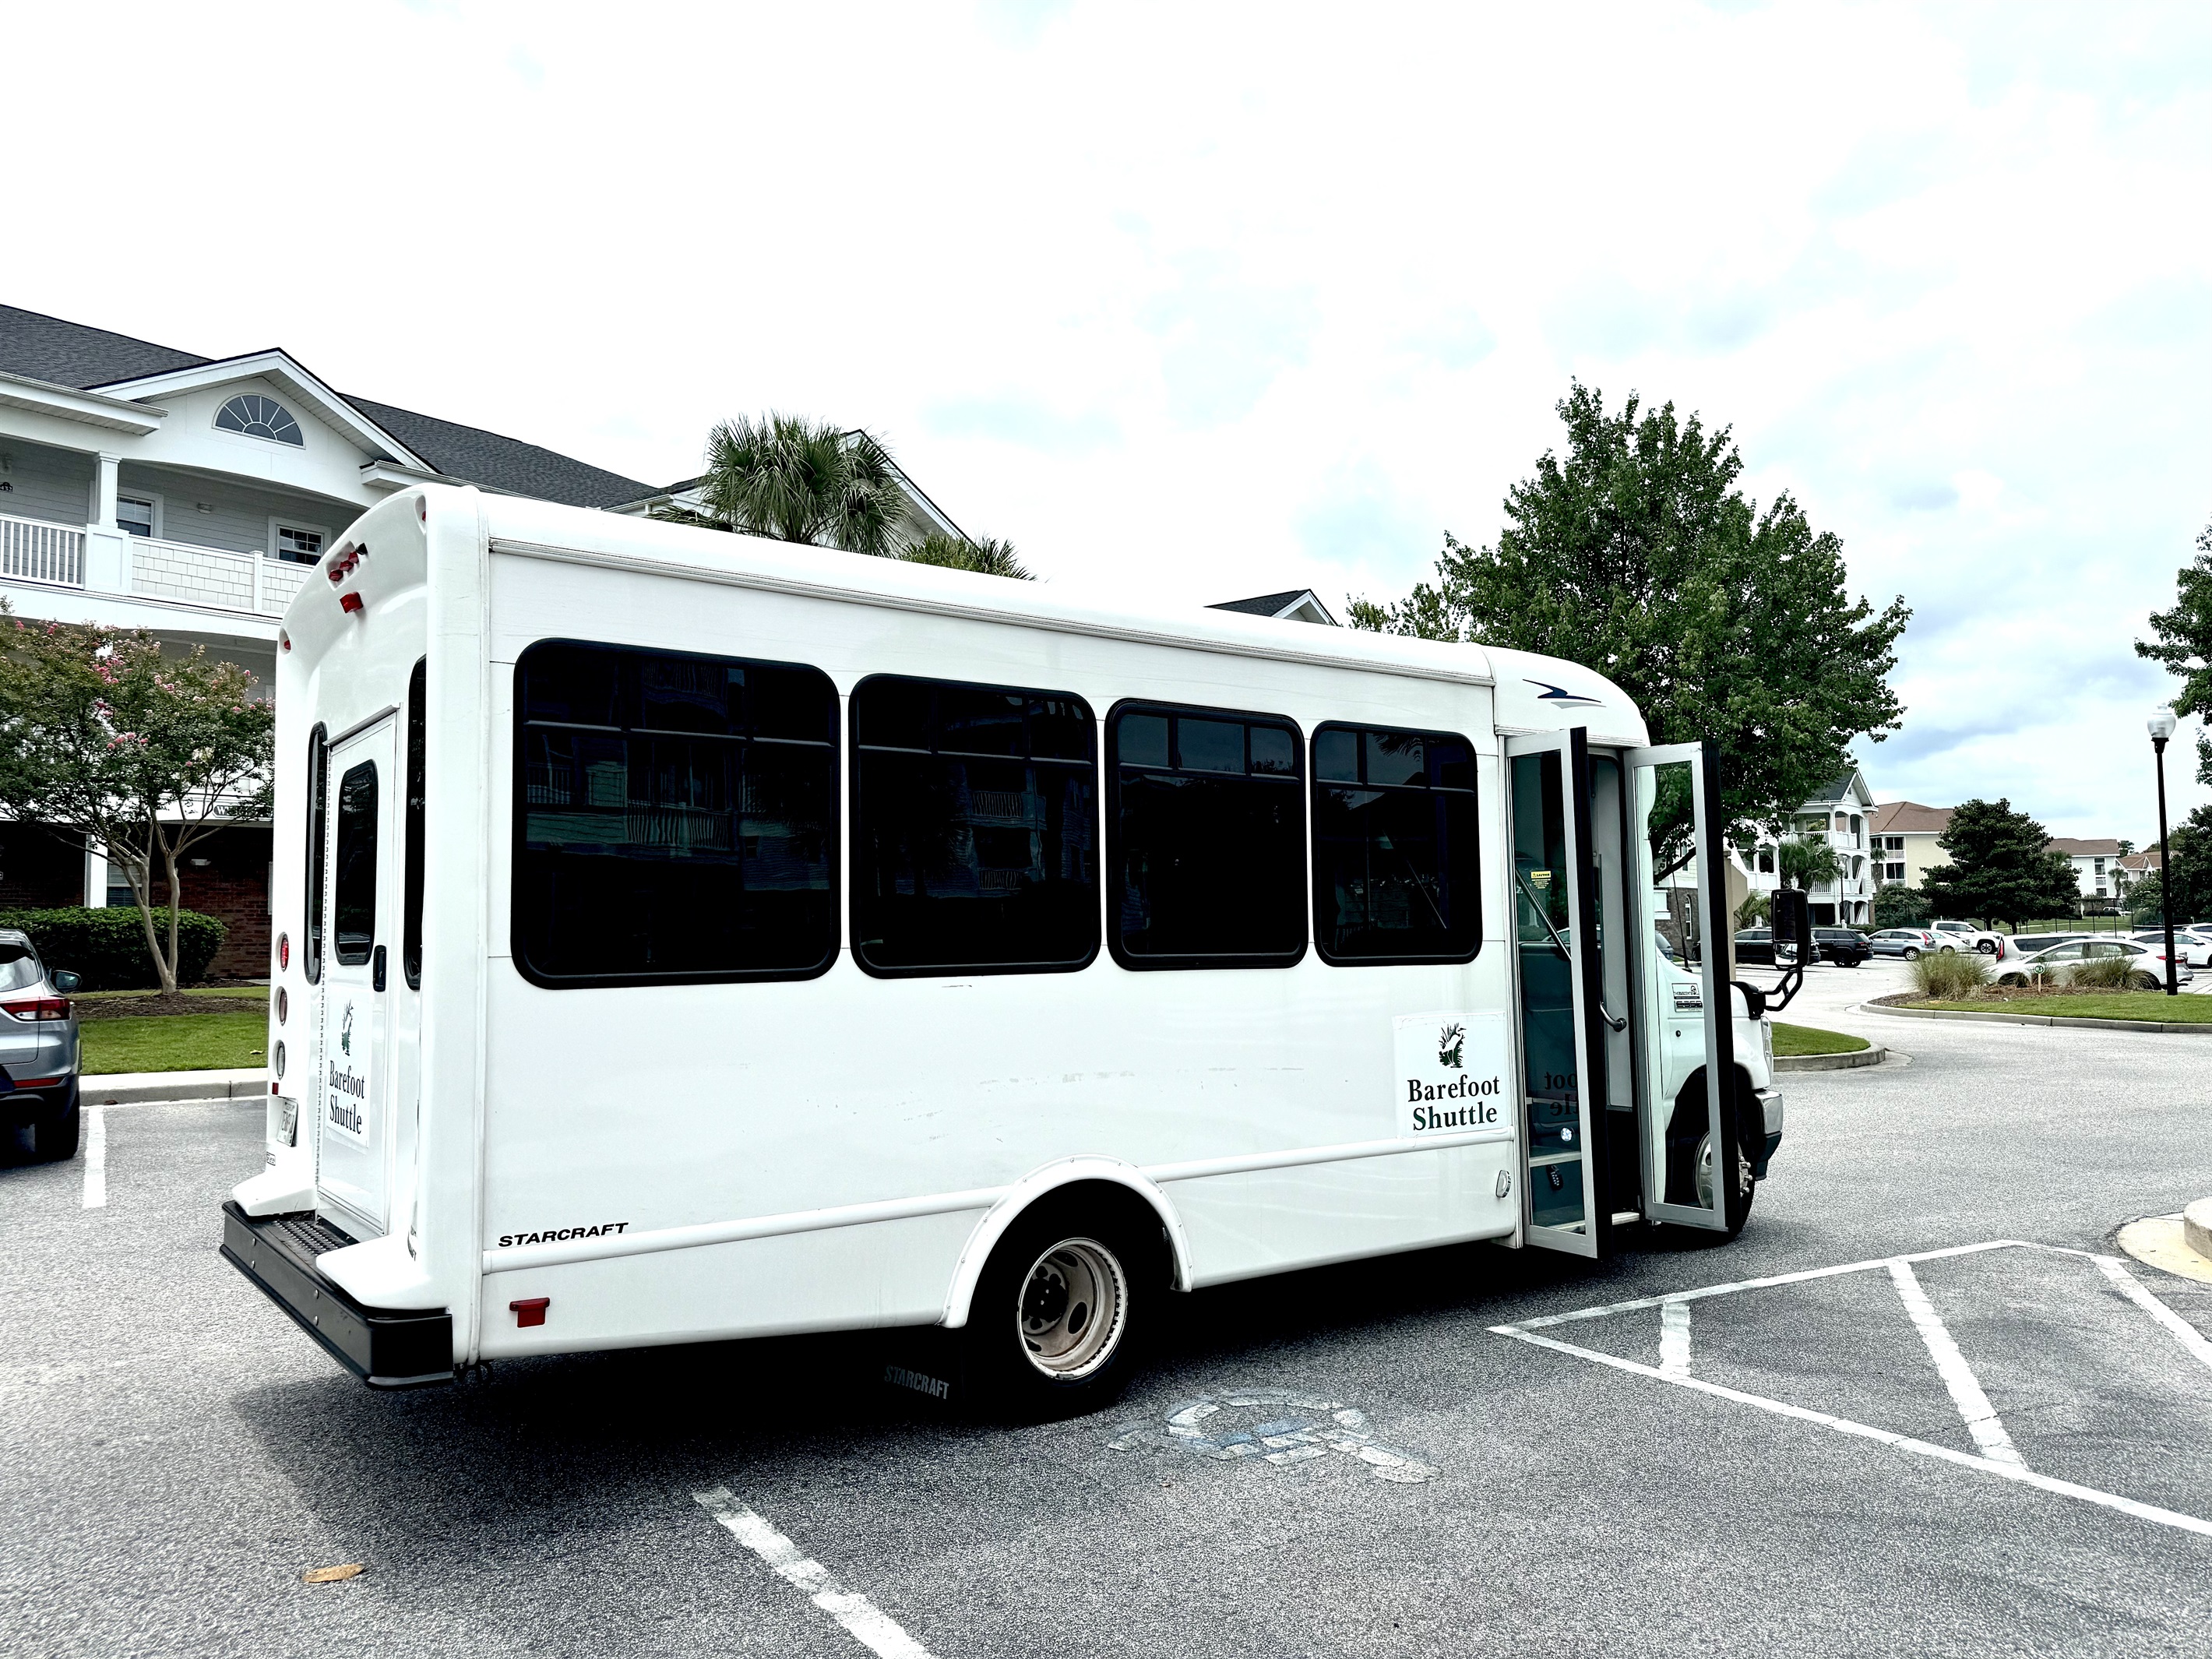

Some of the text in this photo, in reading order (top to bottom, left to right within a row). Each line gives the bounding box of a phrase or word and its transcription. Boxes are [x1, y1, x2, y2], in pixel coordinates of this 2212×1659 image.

[329, 1059, 365, 1100] Barefoot
[1407, 1074, 1500, 1102] Barefoot
[329, 1094, 362, 1135] Shuttle
[1413, 1101, 1497, 1131] Shuttle
[498, 1222, 629, 1248] STARCRAFT
[884, 1365, 949, 1400] STARCRAFT
